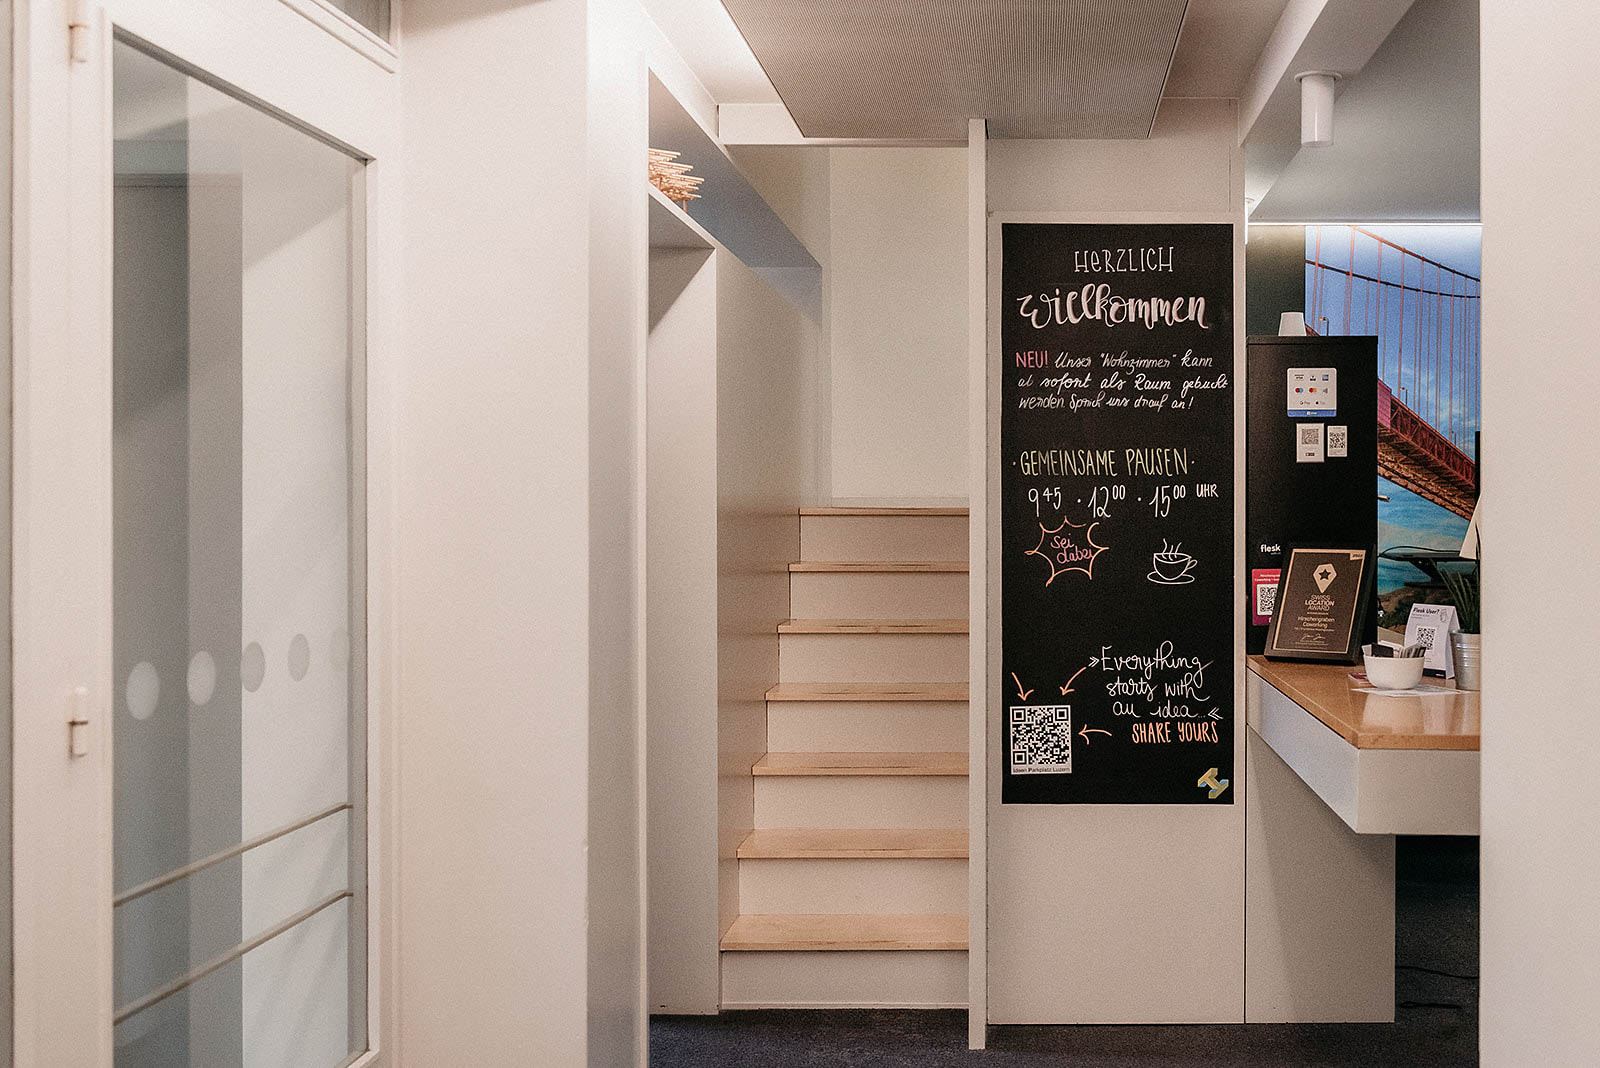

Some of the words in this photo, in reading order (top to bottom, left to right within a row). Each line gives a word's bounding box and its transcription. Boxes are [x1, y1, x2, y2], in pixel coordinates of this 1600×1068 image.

[1015, 350, 1049, 368] NEU!
[1181, 348, 1213, 368] kann
[1039, 372, 1092, 395] sofort
[1100, 371, 1126, 390] als
[1134, 373, 1171, 390] Raum
[1106, 397, 1130, 408] uns
[1134, 393, 1169, 413] drauf
[1171, 397, 1193, 410] an!
[1020, 449, 1118, 477] GEMEINSAME
[1125, 447, 1188, 477] PAUSEN
[1196, 483, 1219, 498] UHR
[1050, 533, 1075, 549] Sei
[1260, 543, 1281, 553] flesk
[1056, 546, 1094, 564] dabei
[1106, 676, 1158, 702] starts
[1164, 672, 1210, 701] with
[1131, 720, 1171, 744] SHARE
[1178, 720, 1219, 744] YOURS
